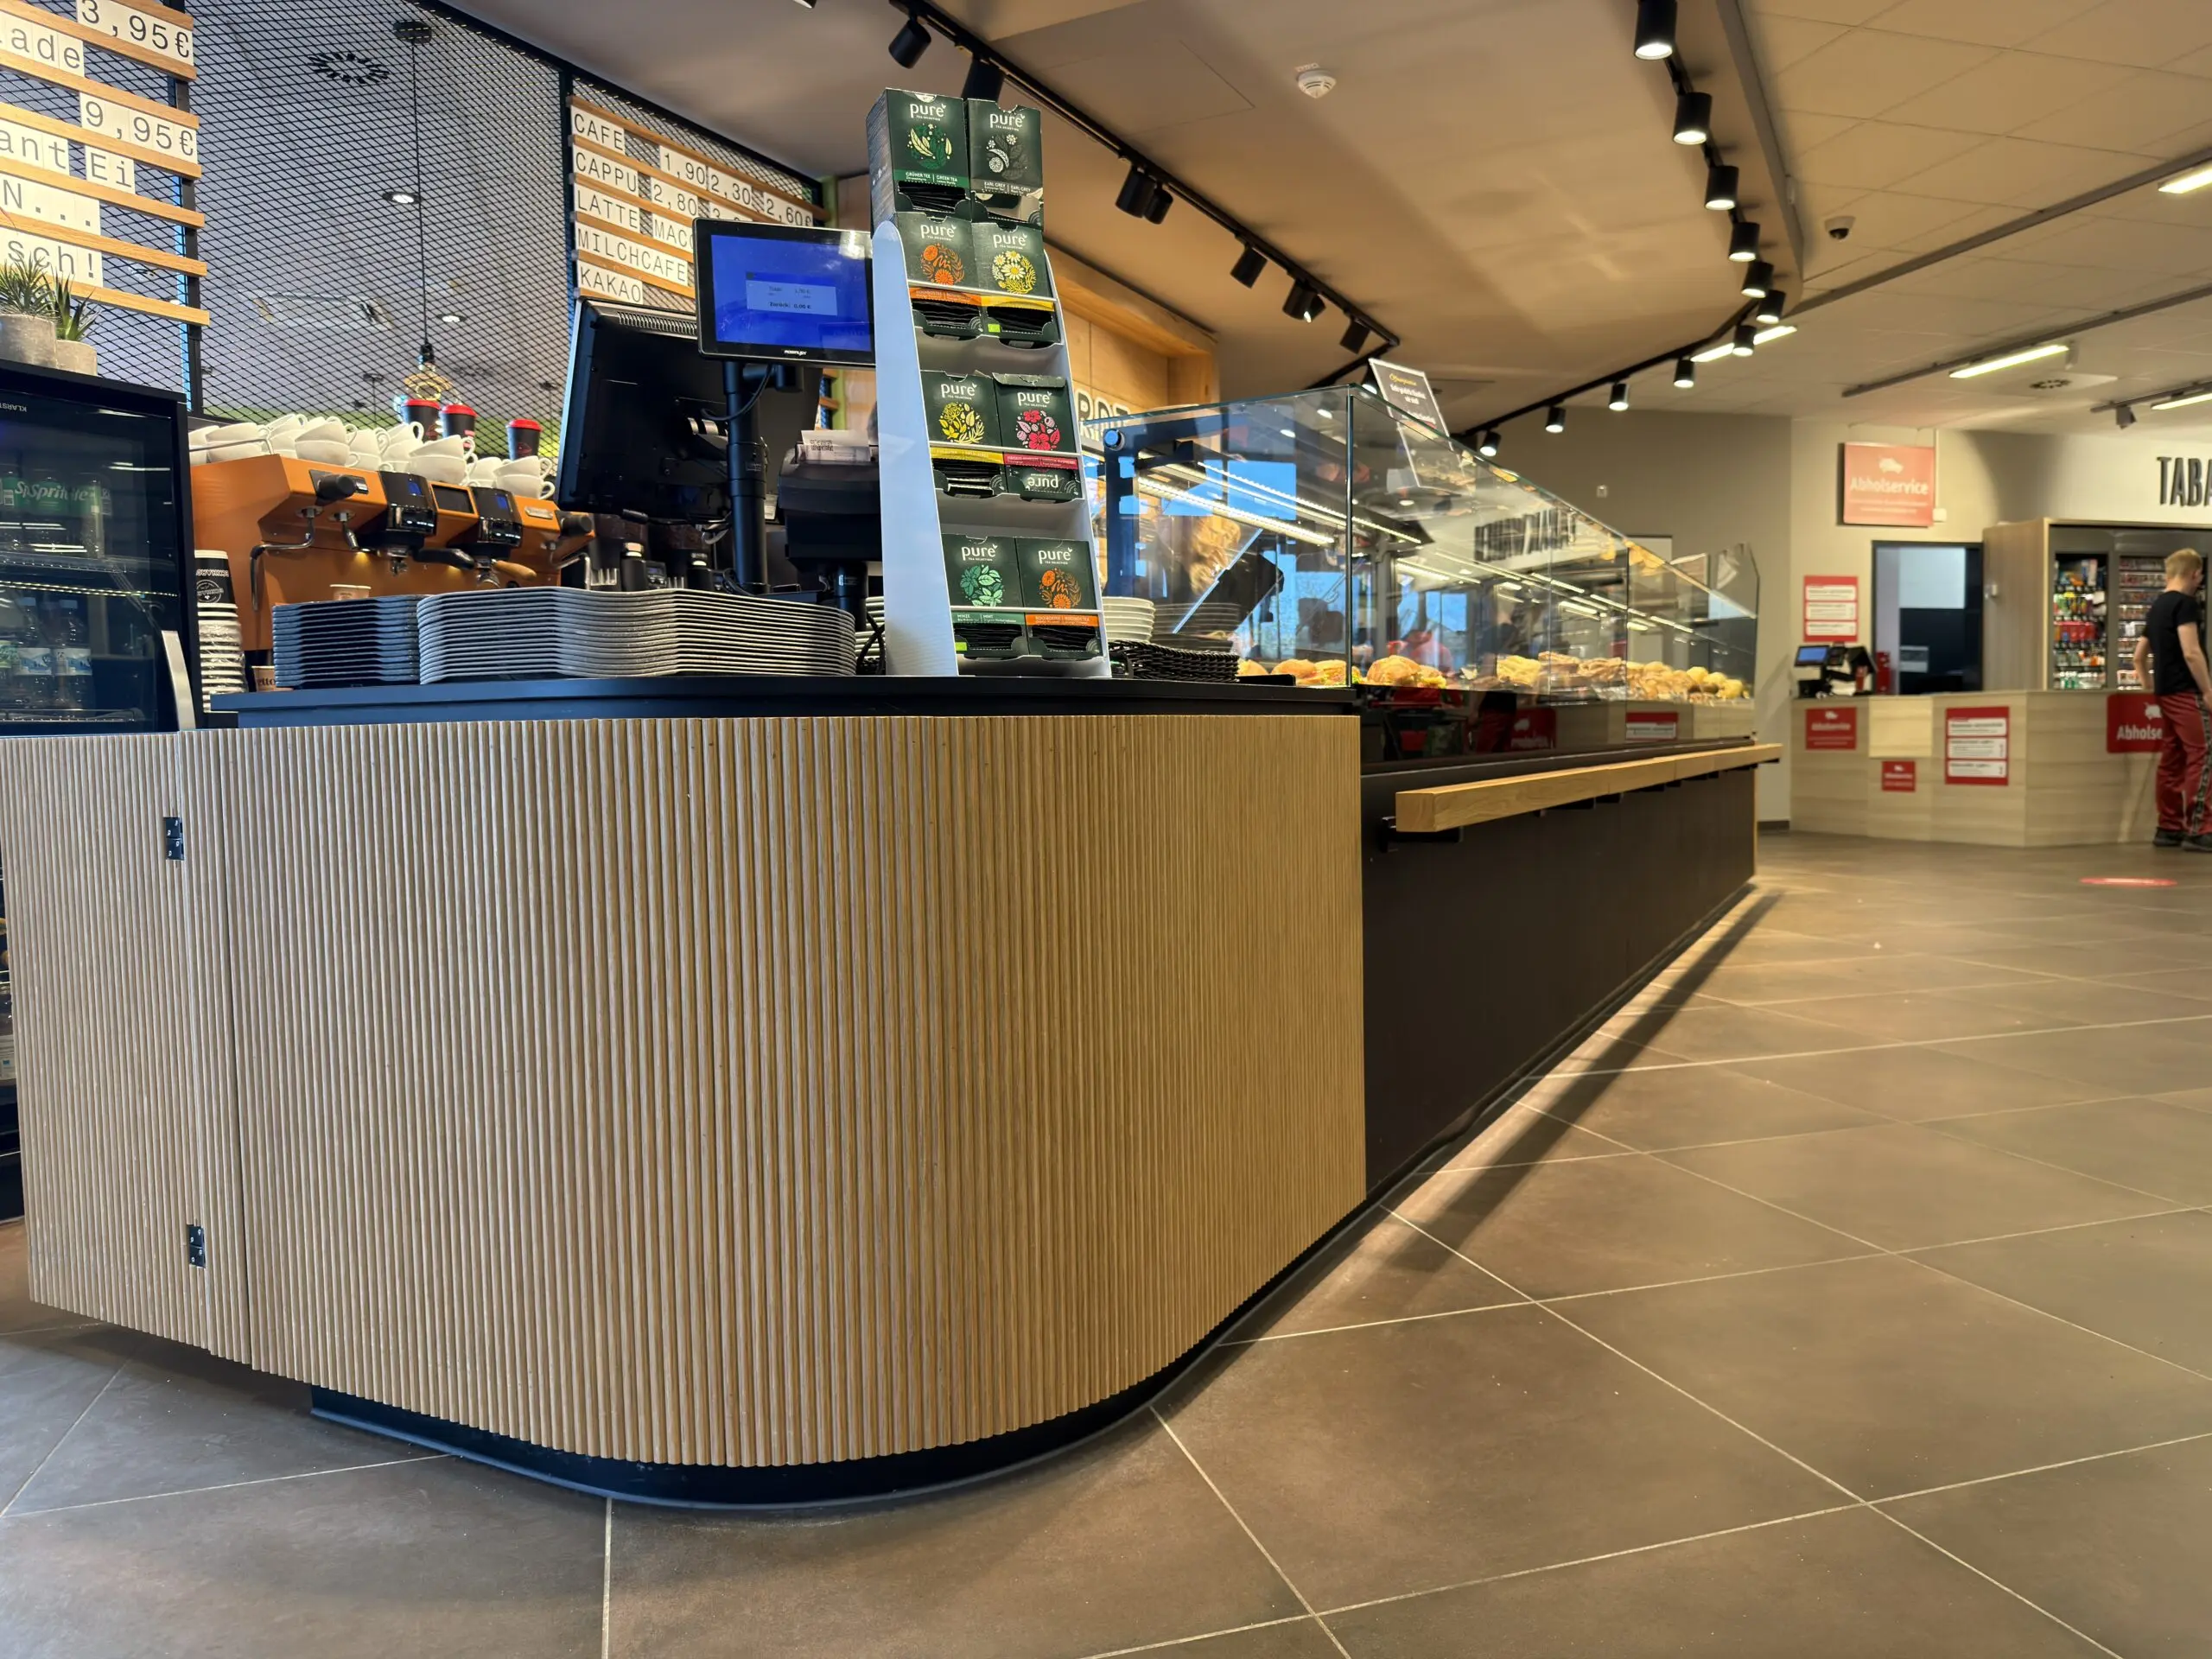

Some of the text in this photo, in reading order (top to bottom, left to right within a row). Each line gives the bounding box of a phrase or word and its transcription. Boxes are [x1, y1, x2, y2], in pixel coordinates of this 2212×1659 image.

[82, 0, 189, 58] 3,95€
[0, 29, 80, 69] ade
[910, 103, 944, 118] pure
[989, 113, 1023, 129] pure
[86, 101, 194, 156] 9,95€
[91, 152, 132, 188] Ei
[574, 113, 624, 151] CAFE
[664, 153, 706, 186] 1,90
[710, 175, 752, 206] 2,30
[575, 152, 698, 216] CAPPU 2,80
[577, 189, 693, 250] LATTE MAC
[920, 225, 955, 239] pure
[577, 228, 687, 283] MILCHCAFE
[993, 234, 1027, 248] pure
[8, 240, 93, 278] sch!
[581, 268, 642, 302] KAKAO
[941, 383, 975, 397] pure
[1017, 391, 1050, 406] pure
[961, 546, 996, 561] pure
[1038, 550, 1071, 564] pure
